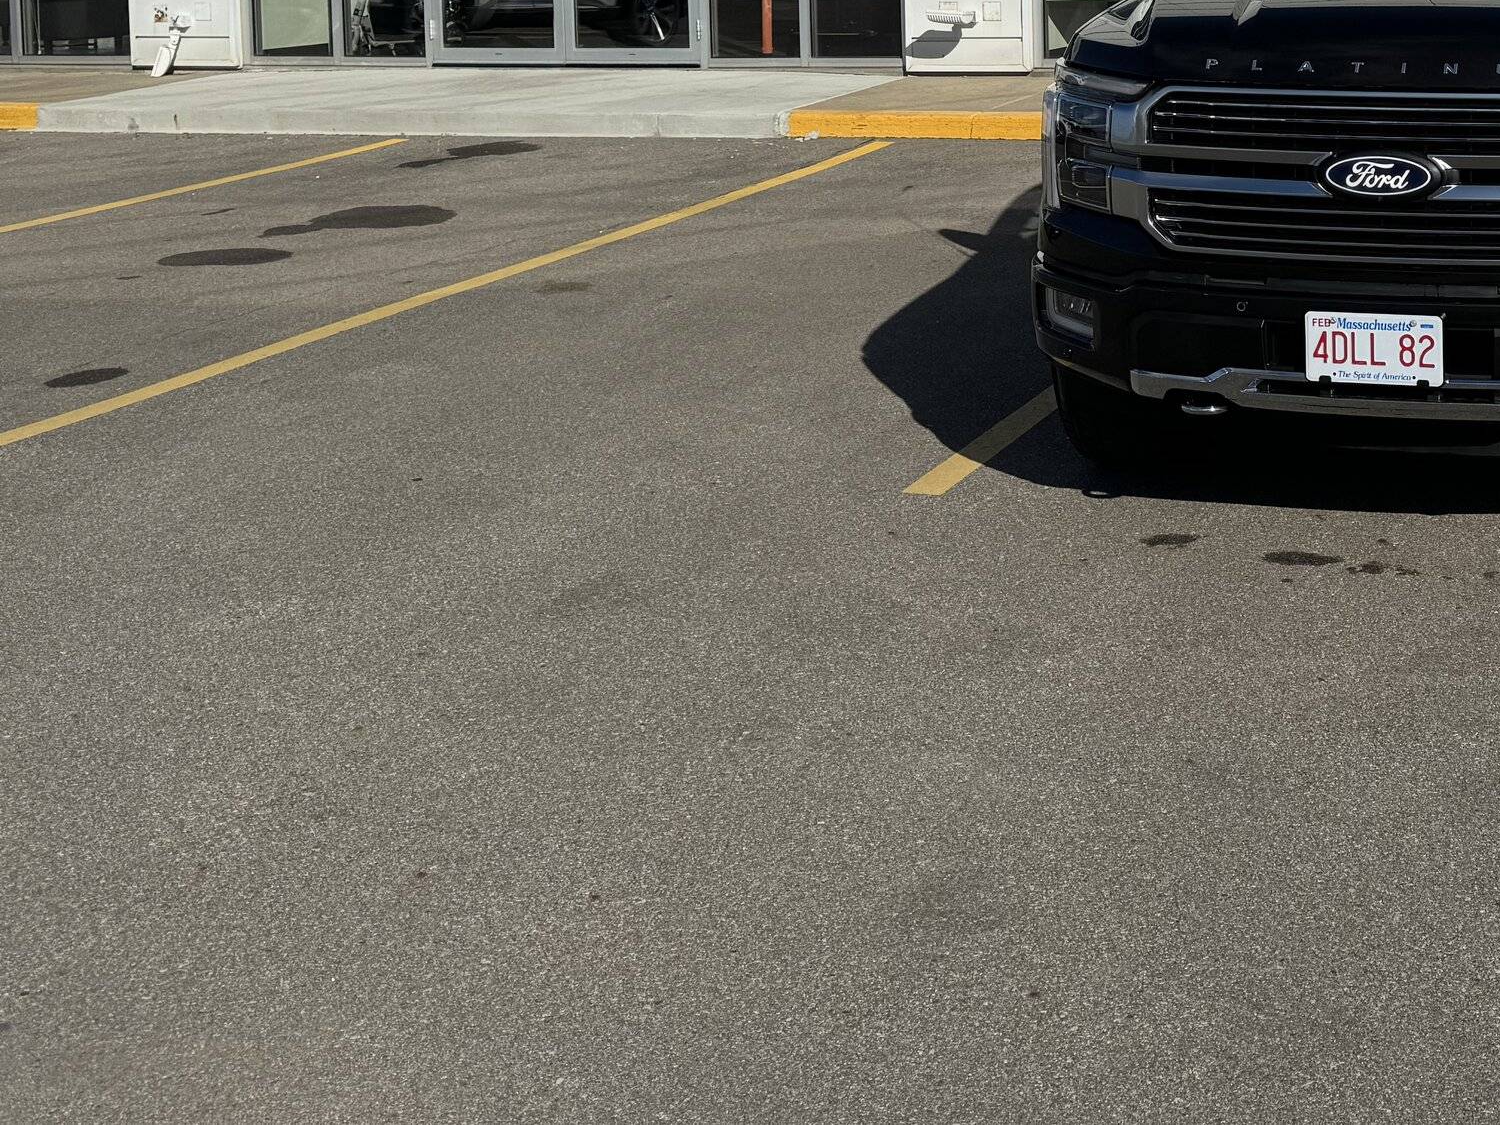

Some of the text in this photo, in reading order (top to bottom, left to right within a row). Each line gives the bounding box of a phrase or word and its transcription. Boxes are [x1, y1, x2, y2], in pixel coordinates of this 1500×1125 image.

[1346, 161, 1411, 189] Ford
[1336, 317, 1412, 332] Massachusetts
[1313, 331, 1435, 368] 4DLL 82
[1338, 370, 1412, 381] The Spirit of America
